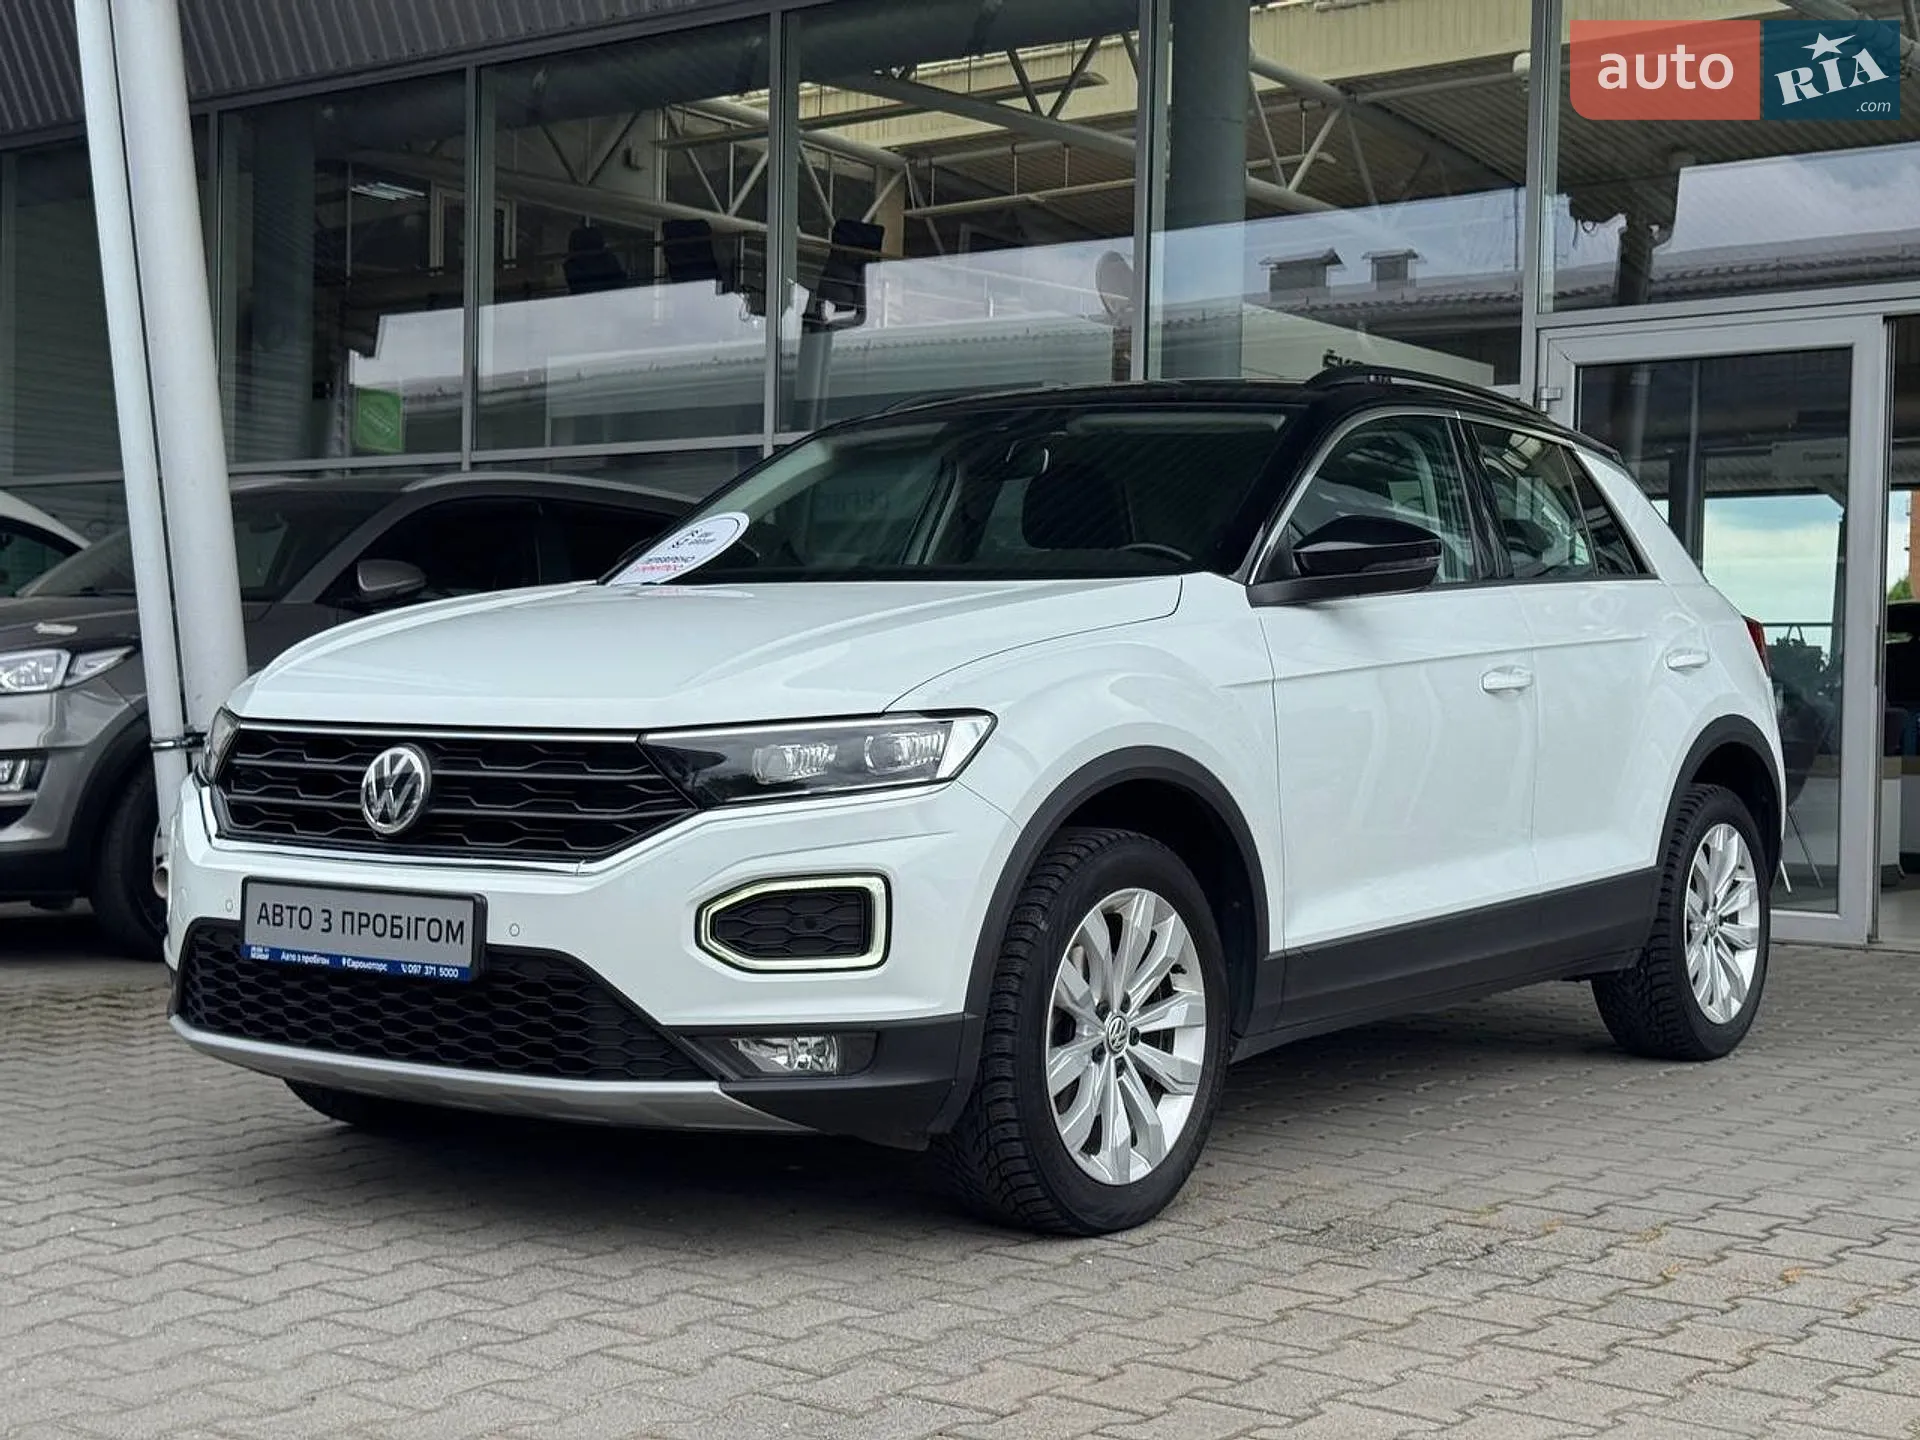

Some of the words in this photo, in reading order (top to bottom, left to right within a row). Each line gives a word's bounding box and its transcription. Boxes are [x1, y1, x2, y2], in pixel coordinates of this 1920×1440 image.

[257, 901, 312, 931] АВТО
[321, 908, 333, 933] З
[341, 911, 465, 945] ПРОБІГОМ
[408, 964, 421, 975] 097
